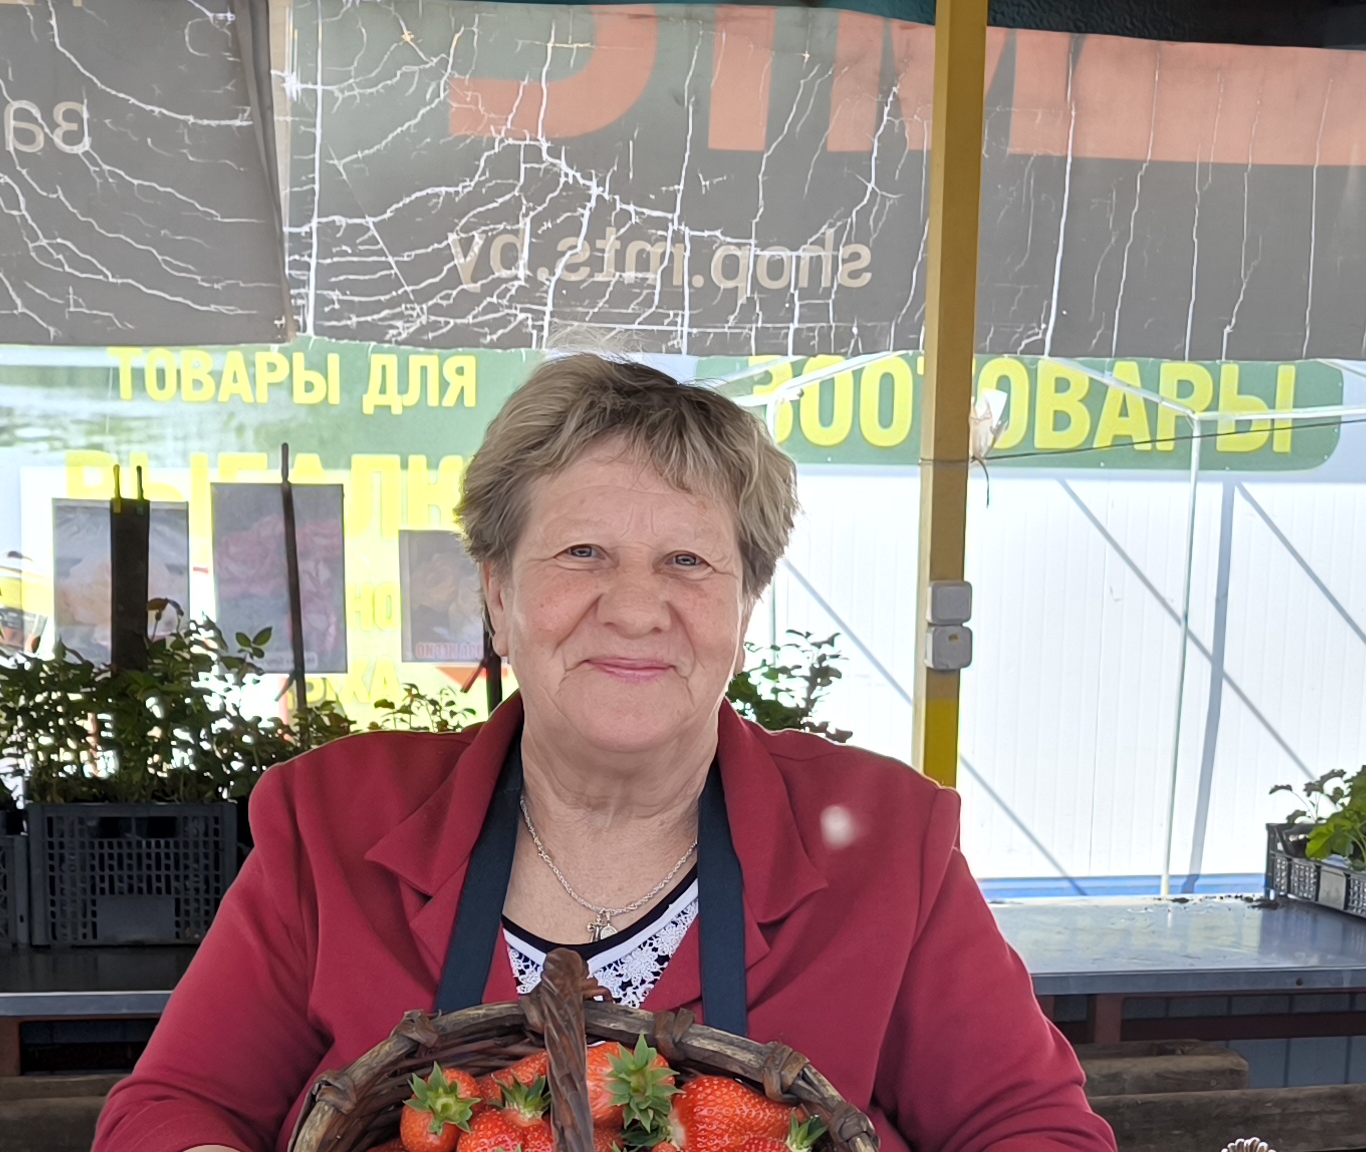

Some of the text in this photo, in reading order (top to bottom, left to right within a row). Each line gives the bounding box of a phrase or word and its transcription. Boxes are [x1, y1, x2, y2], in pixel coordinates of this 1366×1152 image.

[107, 347, 476, 414] ТОВАРЫ ДЛЯ
[748, 354, 1296, 455] ЗОООВАРЫ
